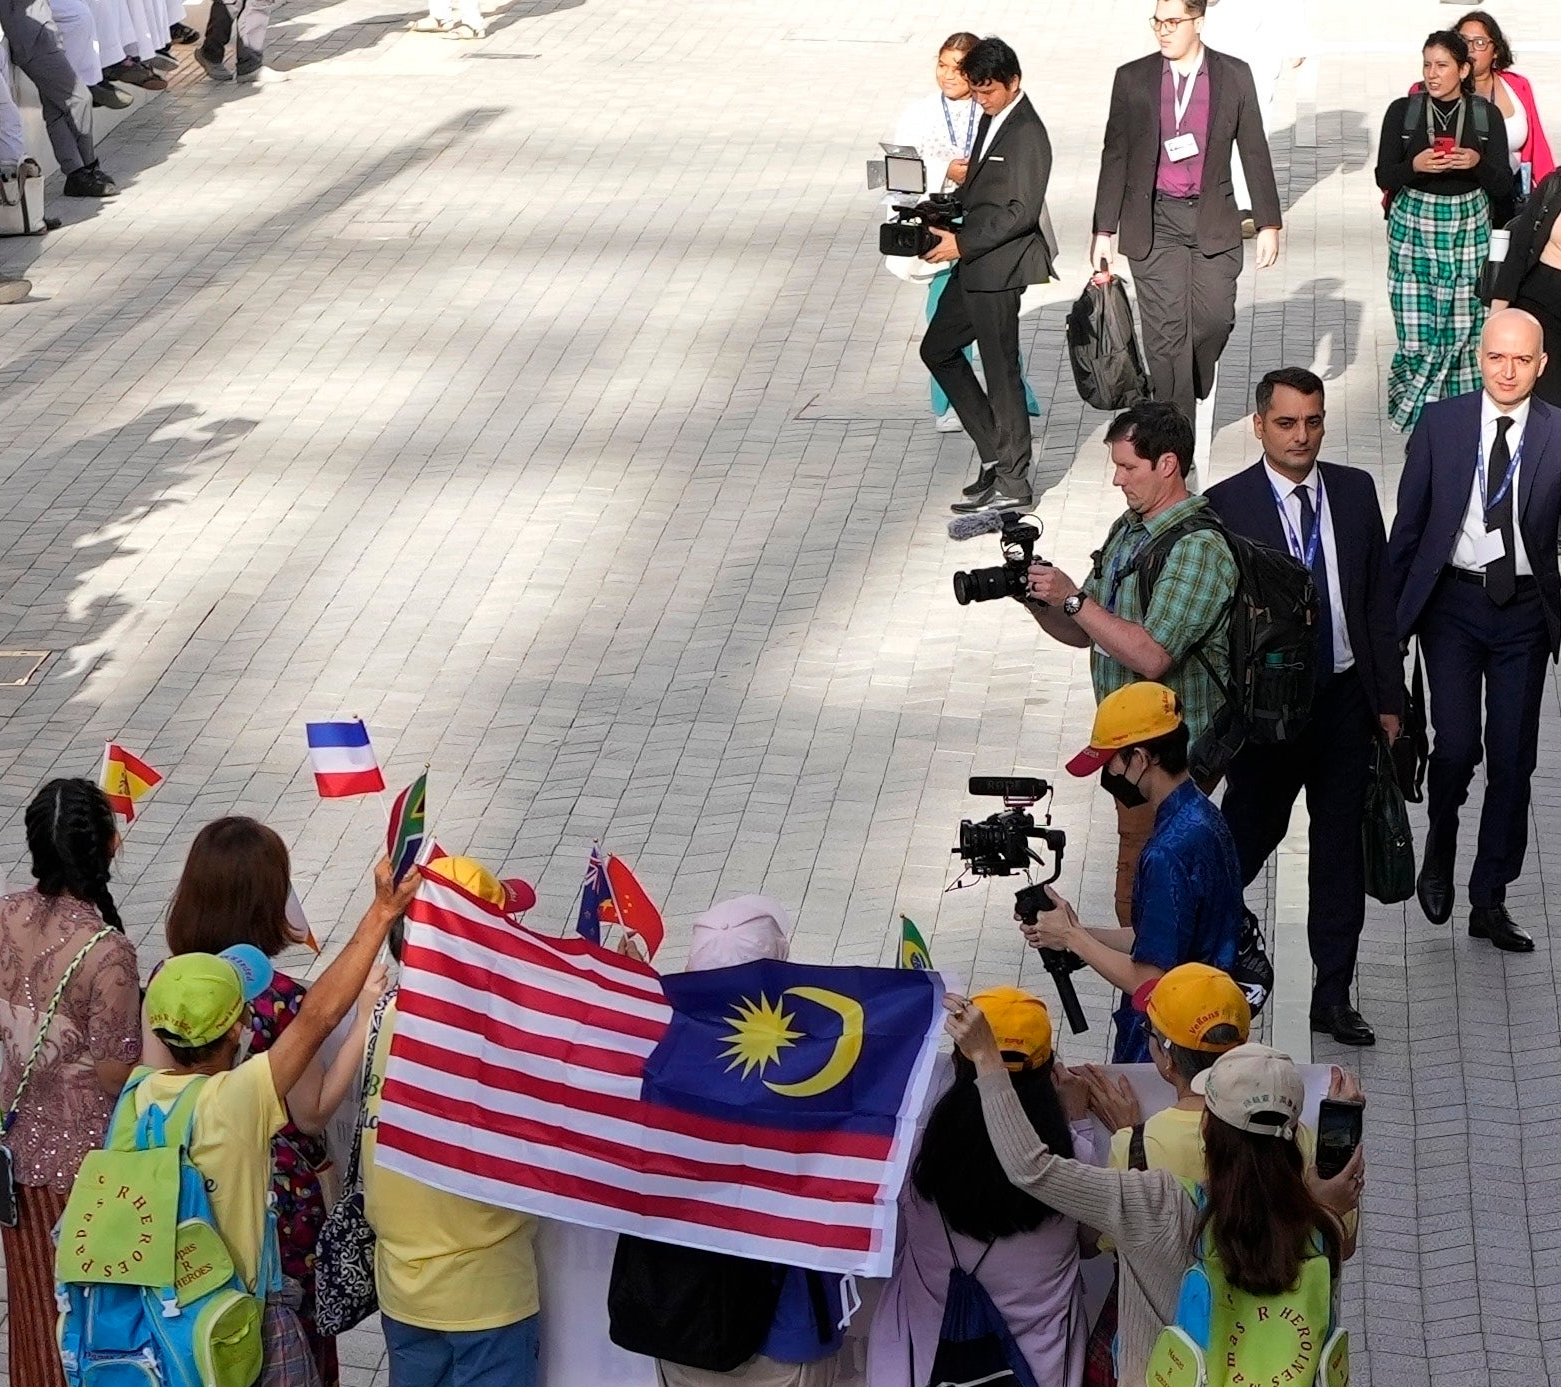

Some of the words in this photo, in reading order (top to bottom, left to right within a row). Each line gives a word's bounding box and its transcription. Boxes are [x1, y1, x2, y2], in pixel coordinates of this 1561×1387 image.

[116, 1185, 130, 1200] R
[103, 1195, 153, 1278] HEROES
[182, 1260, 193, 1273] R
[1257, 1306, 1270, 1322] R
[1271, 1306, 1313, 1387] HEROINES
